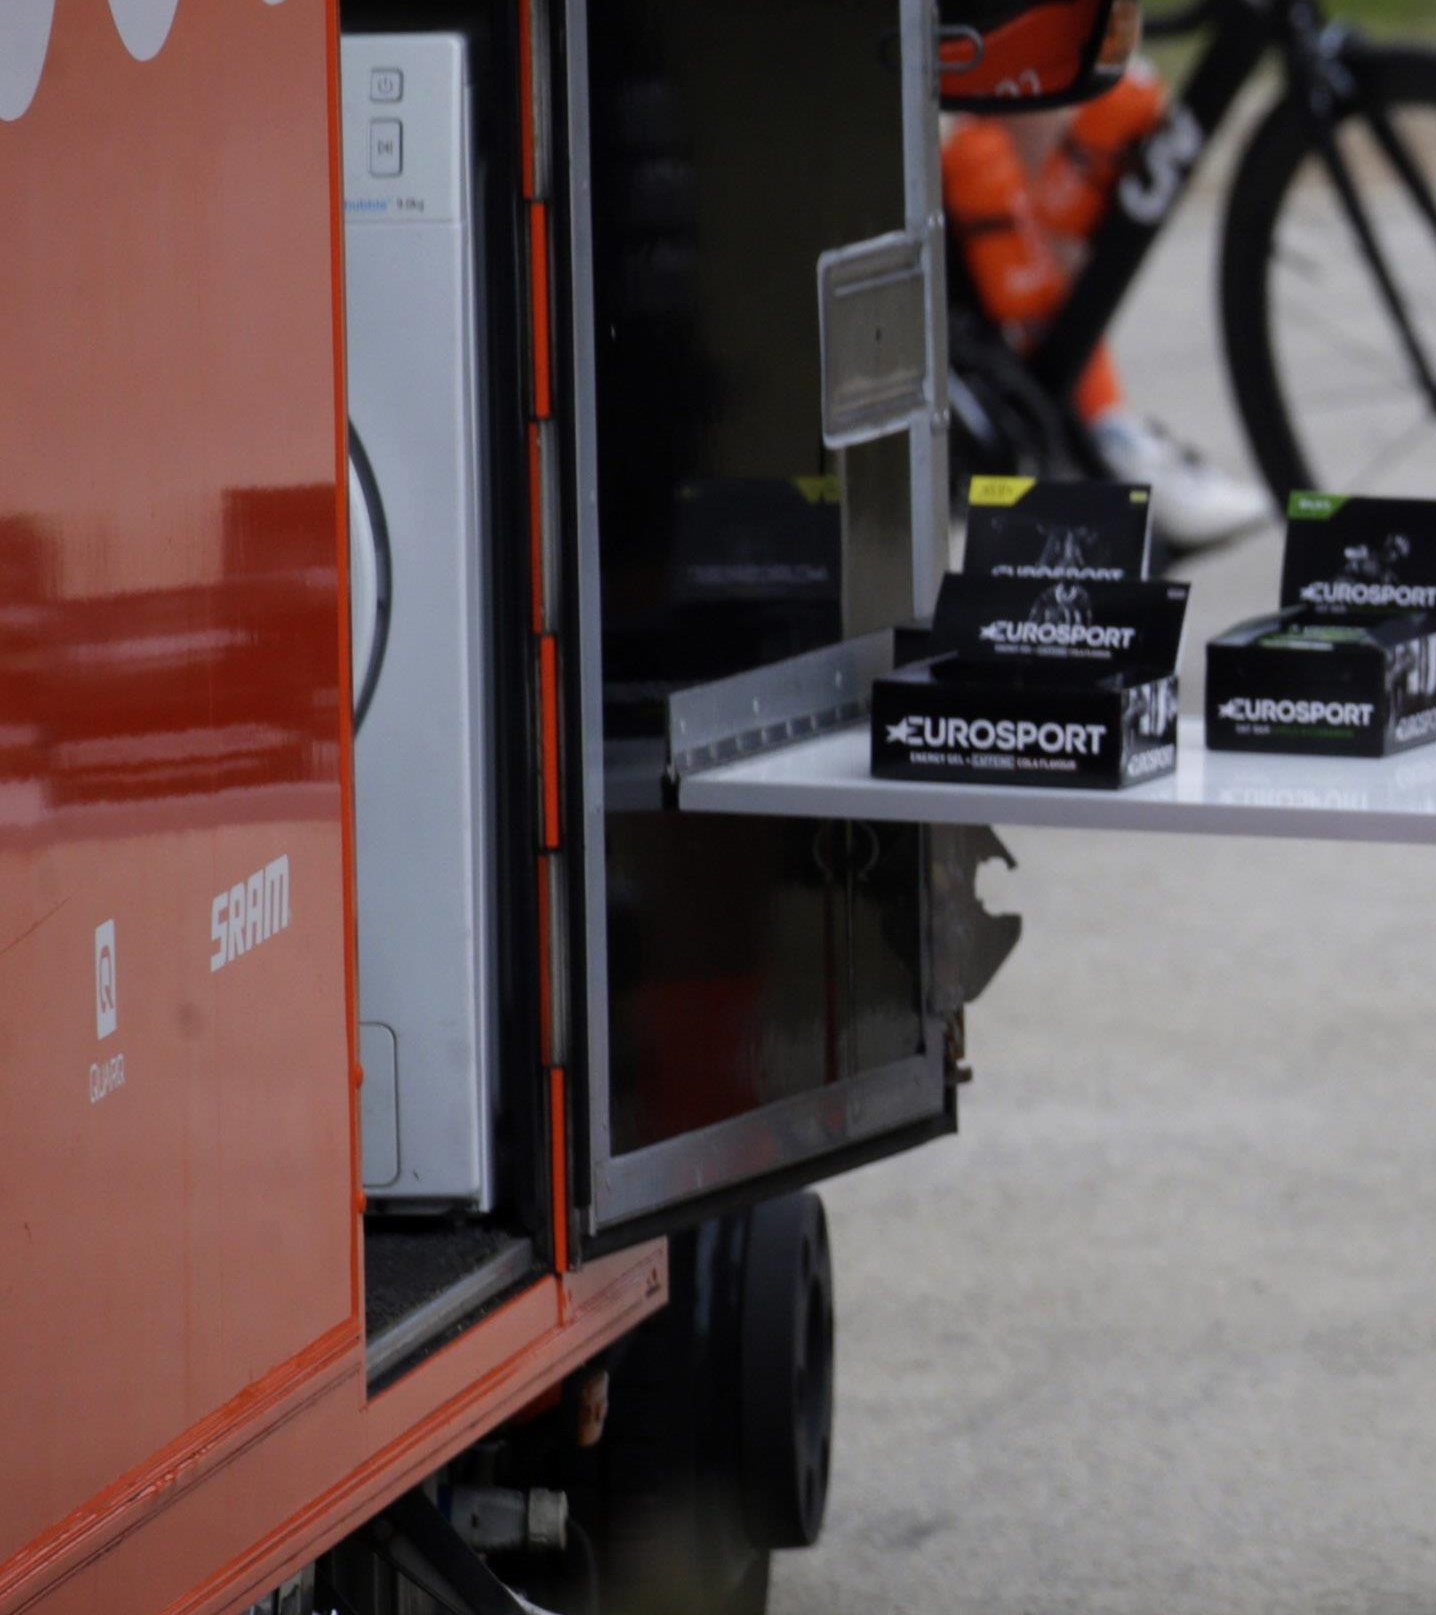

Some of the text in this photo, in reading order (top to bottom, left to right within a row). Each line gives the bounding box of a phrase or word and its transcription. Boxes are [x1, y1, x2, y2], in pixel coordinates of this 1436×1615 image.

[983, 621, 1136, 649] EUROSPORT
[1222, 698, 1374, 727] EUROSPORT
[890, 716, 1107, 754] EUROSPORT
[210, 854, 290, 973] SRAM
